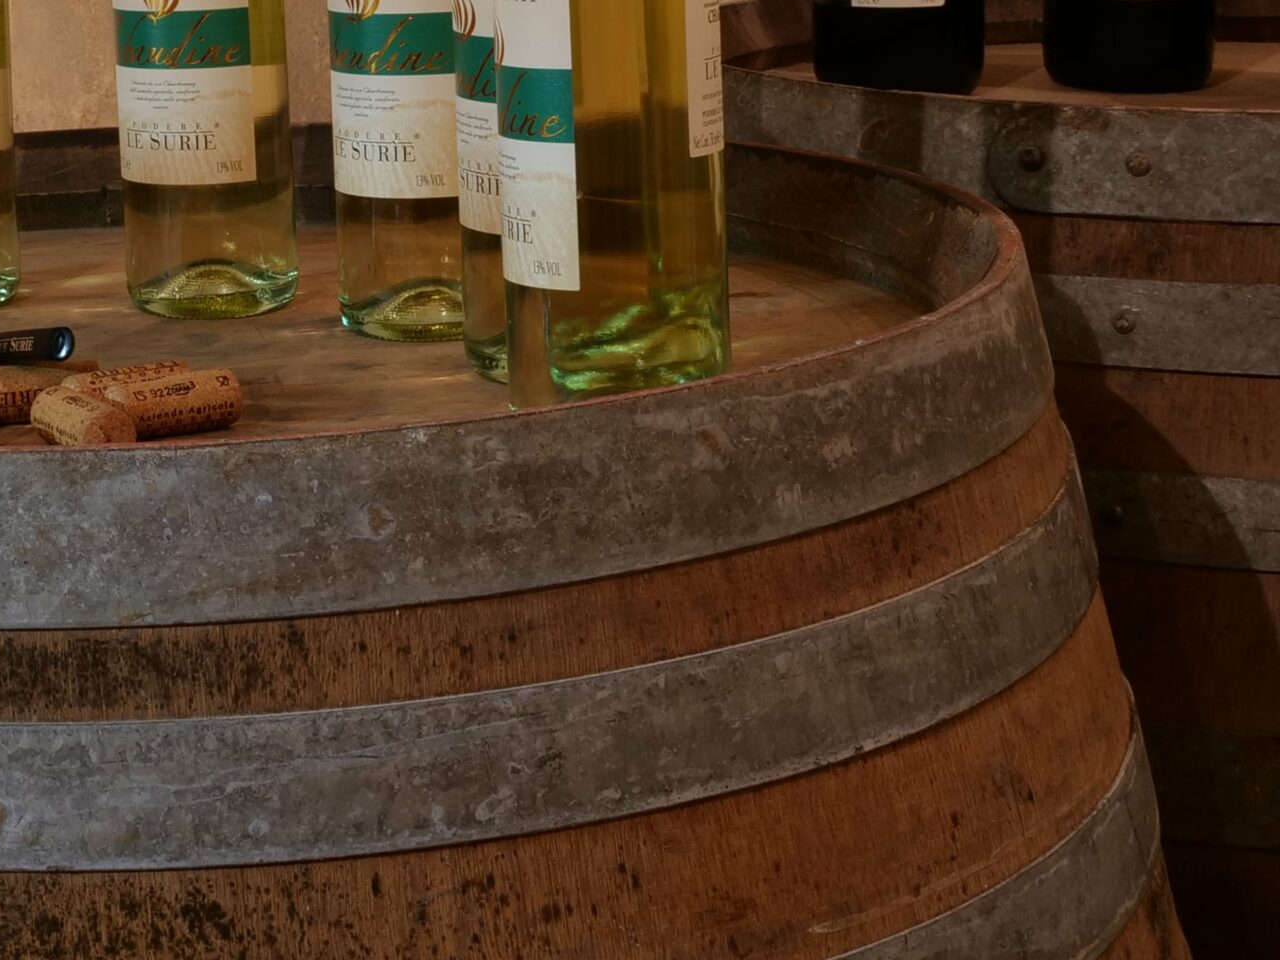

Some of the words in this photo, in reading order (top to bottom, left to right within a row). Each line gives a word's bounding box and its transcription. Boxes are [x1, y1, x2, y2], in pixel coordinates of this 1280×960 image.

[131, 122, 202, 131] PODERE
[126, 131, 144, 149] LE
[334, 140, 347, 158] LE
[230, 159, 244, 172] VOL
[430, 173, 446, 187] VOL
[546, 260, 562, 277] VOL
[9, 337, 35, 353] SURIE
[138, 408, 185, 424] Azienda
[189, 400, 235, 415] Agricola
